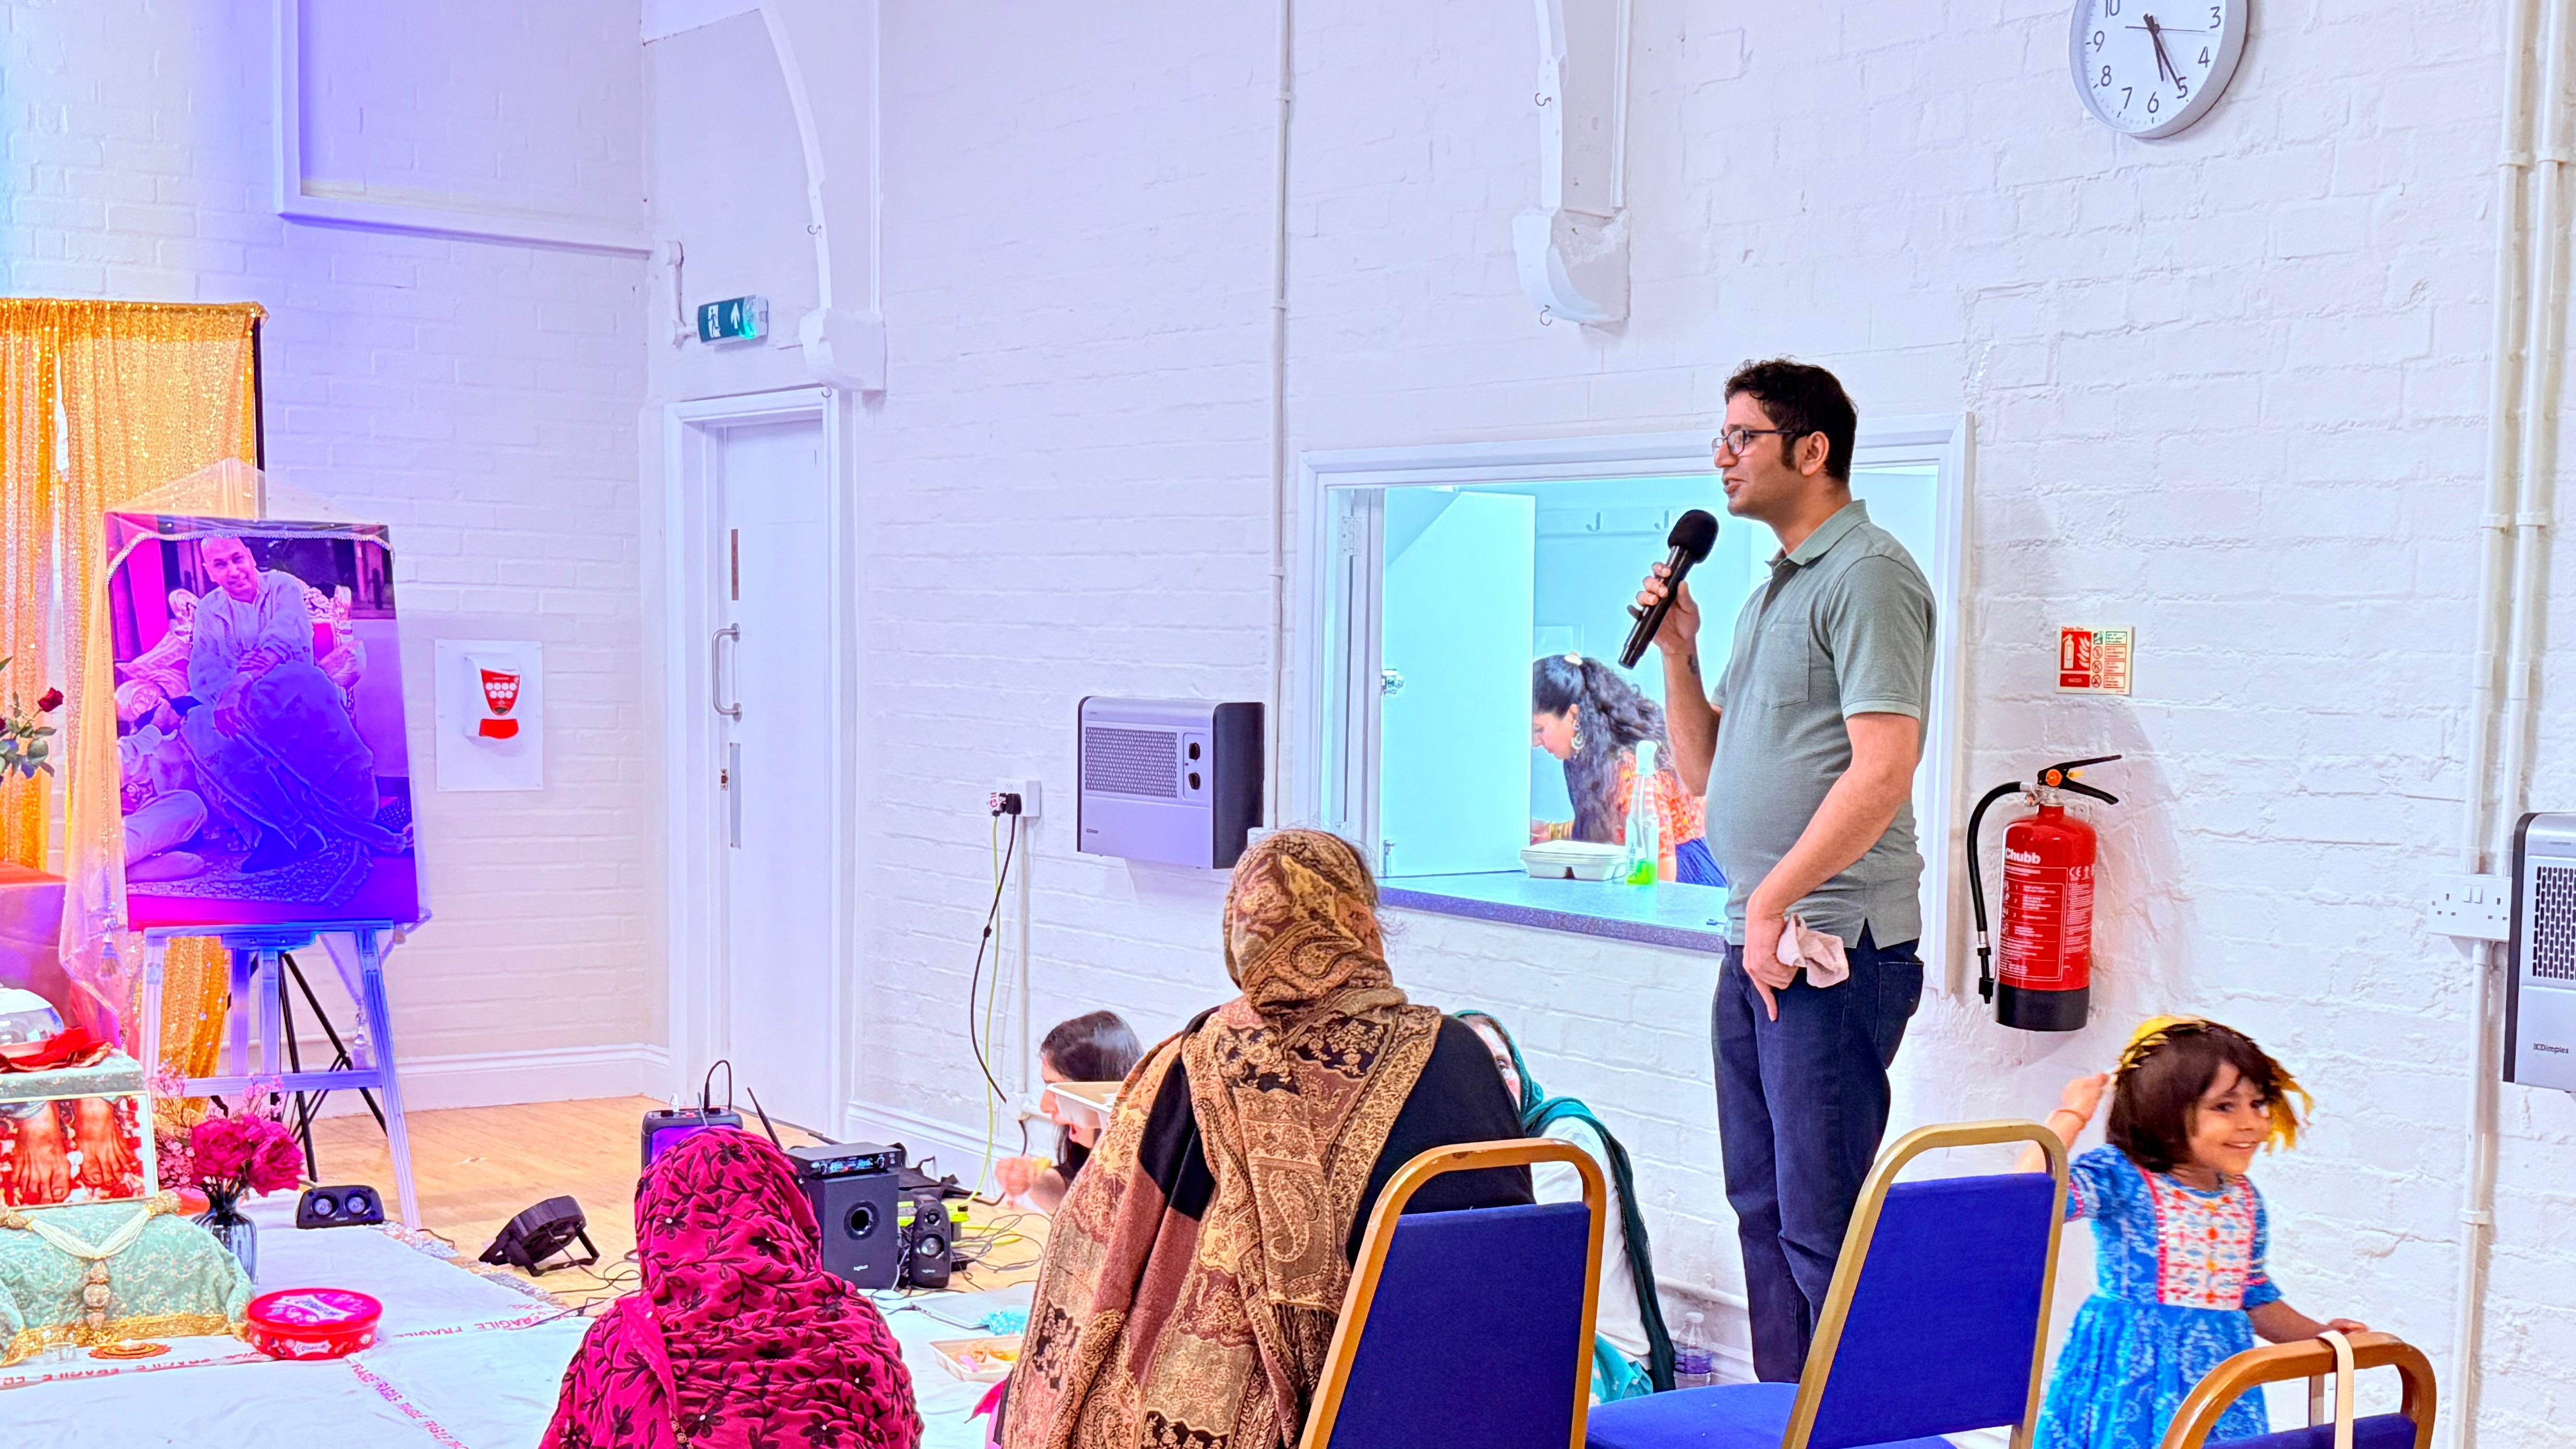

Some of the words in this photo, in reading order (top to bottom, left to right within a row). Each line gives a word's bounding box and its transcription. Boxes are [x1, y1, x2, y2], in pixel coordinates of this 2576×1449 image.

[2105, 0, 2120, 18] 10
[2210, 6, 2221, 29] 3
[2094, 31, 2105, 53] 9
[2198, 46, 2210, 68] 4
[2100, 65, 2111, 86] 8
[2121, 86, 2132, 109] 7
[2177, 77, 2188, 99] 5
[2147, 91, 2159, 113] 6
[2006, 847, 2041, 864] Chubb
